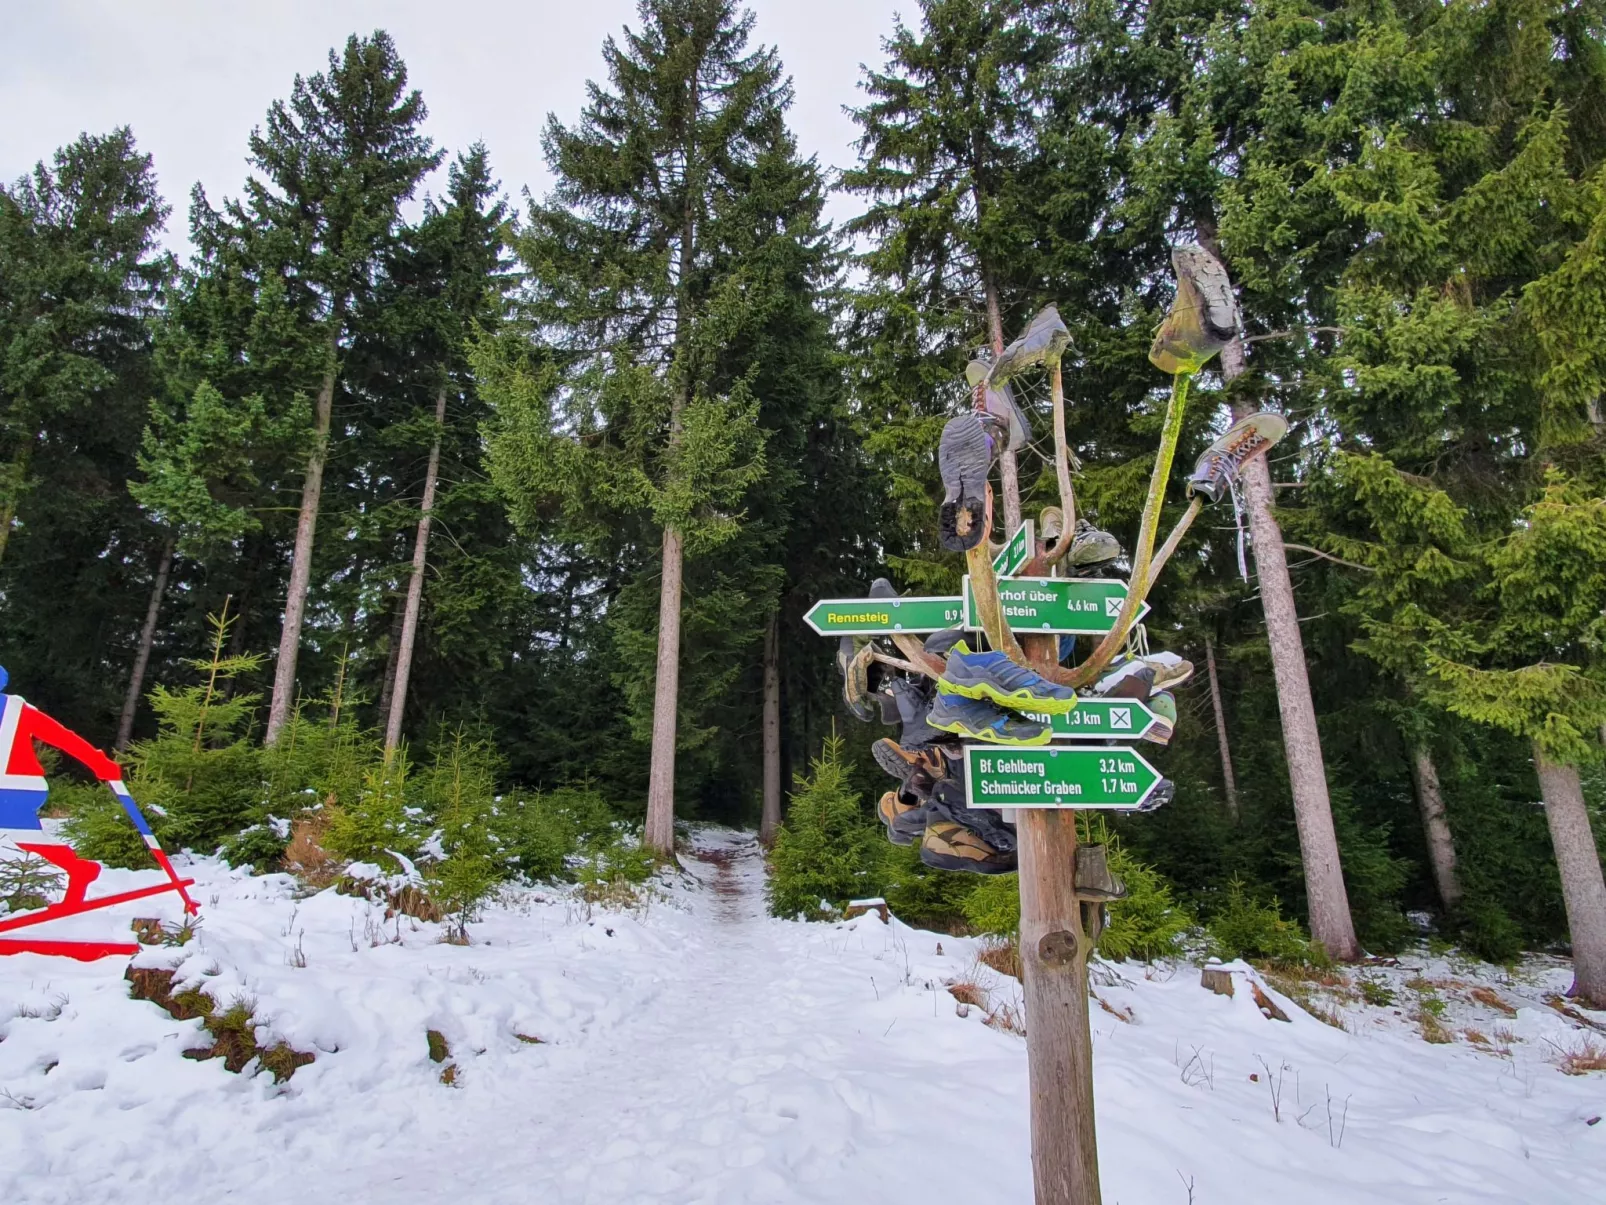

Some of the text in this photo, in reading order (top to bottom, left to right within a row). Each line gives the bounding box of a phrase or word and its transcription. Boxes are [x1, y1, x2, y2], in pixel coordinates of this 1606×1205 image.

[1029, 590, 1058, 602] über
[1083, 600, 1098, 611] km
[827, 613, 889, 624] Rennsteig
[1083, 711, 1101, 725] km
[980, 759, 994, 773] Bf.
[997, 759, 1045, 776] Gehlberg
[1118, 759, 1135, 773] km
[981, 780, 1041, 795] Schmücker
[1044, 781, 1082, 795] Graben
[1120, 779, 1137, 793] km
